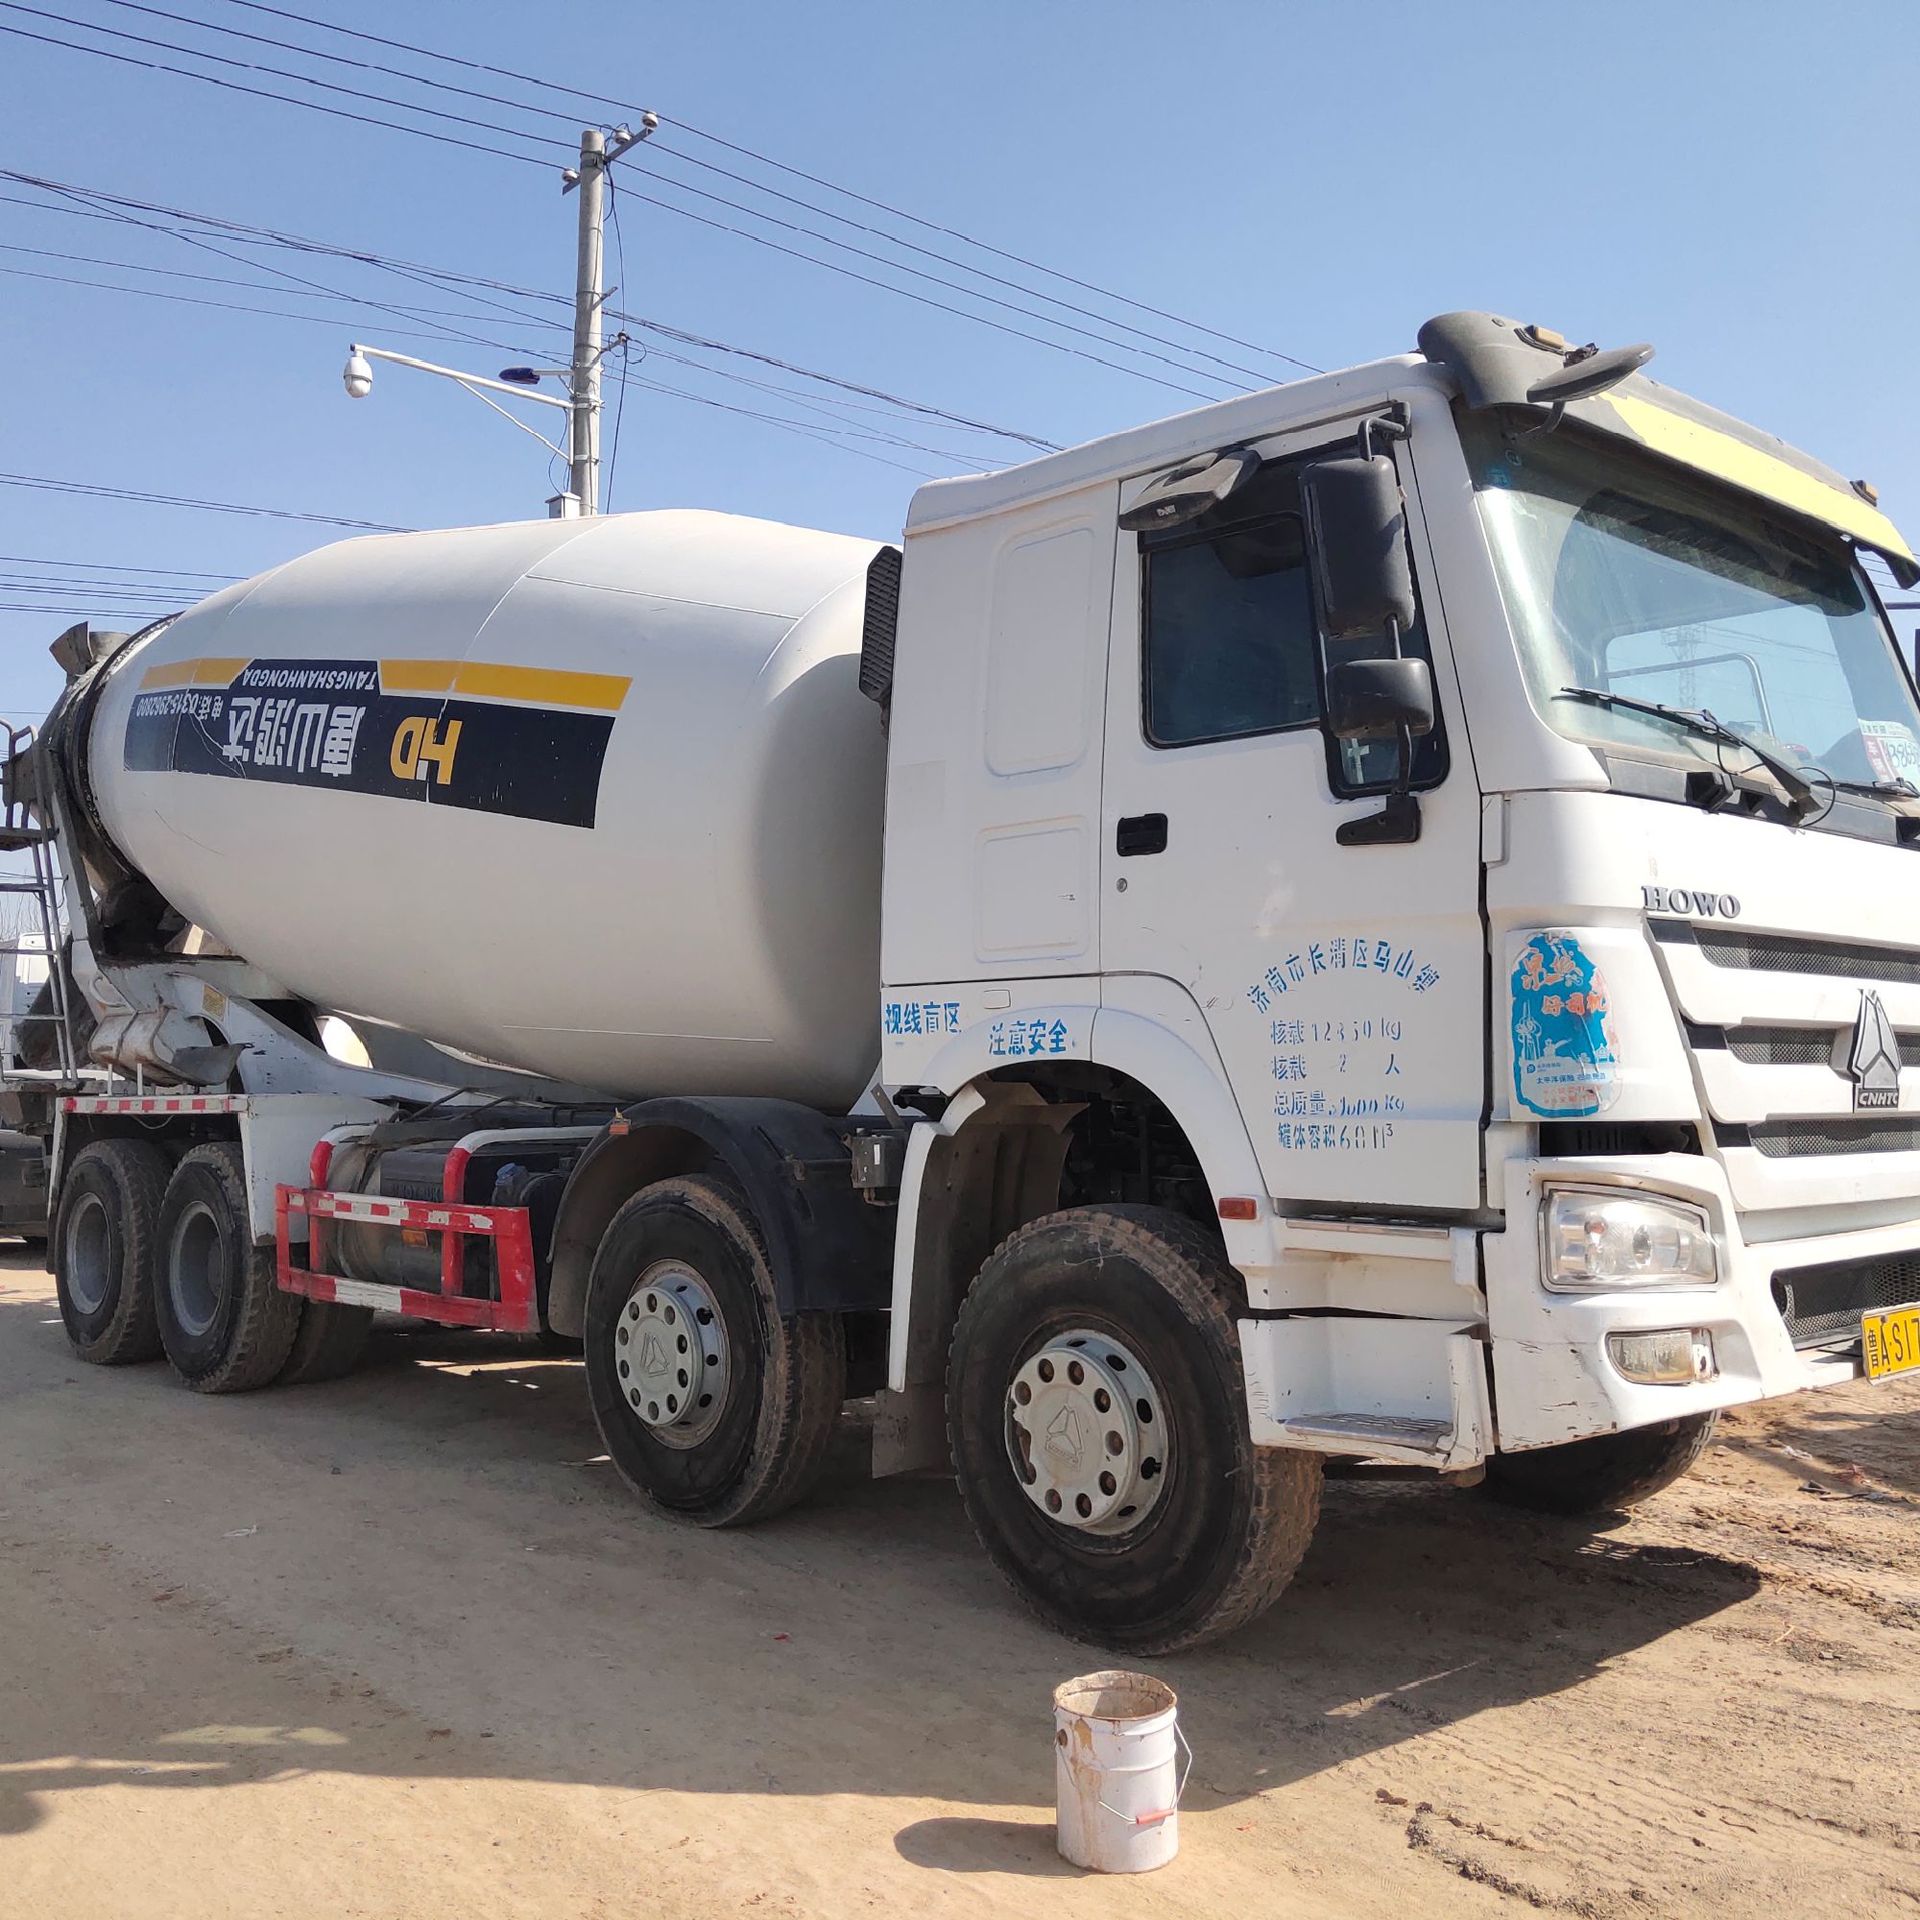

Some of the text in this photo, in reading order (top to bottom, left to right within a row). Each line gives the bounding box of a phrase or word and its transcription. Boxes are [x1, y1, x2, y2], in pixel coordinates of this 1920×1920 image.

[243, 669, 378, 690] TANGSHANHONGDA
[222, 697, 367, 777] 唐山鸿达
[1641, 886, 1741, 919] HOWO
[1246, 937, 1440, 1014] 济南市长清区马山镇
[884, 1001, 961, 1034] 视线盲区
[989, 1018, 1068, 1055] 注意安全
[1271, 1055, 1307, 1081] 核载
[1385, 1053, 1400, 1075] 人
